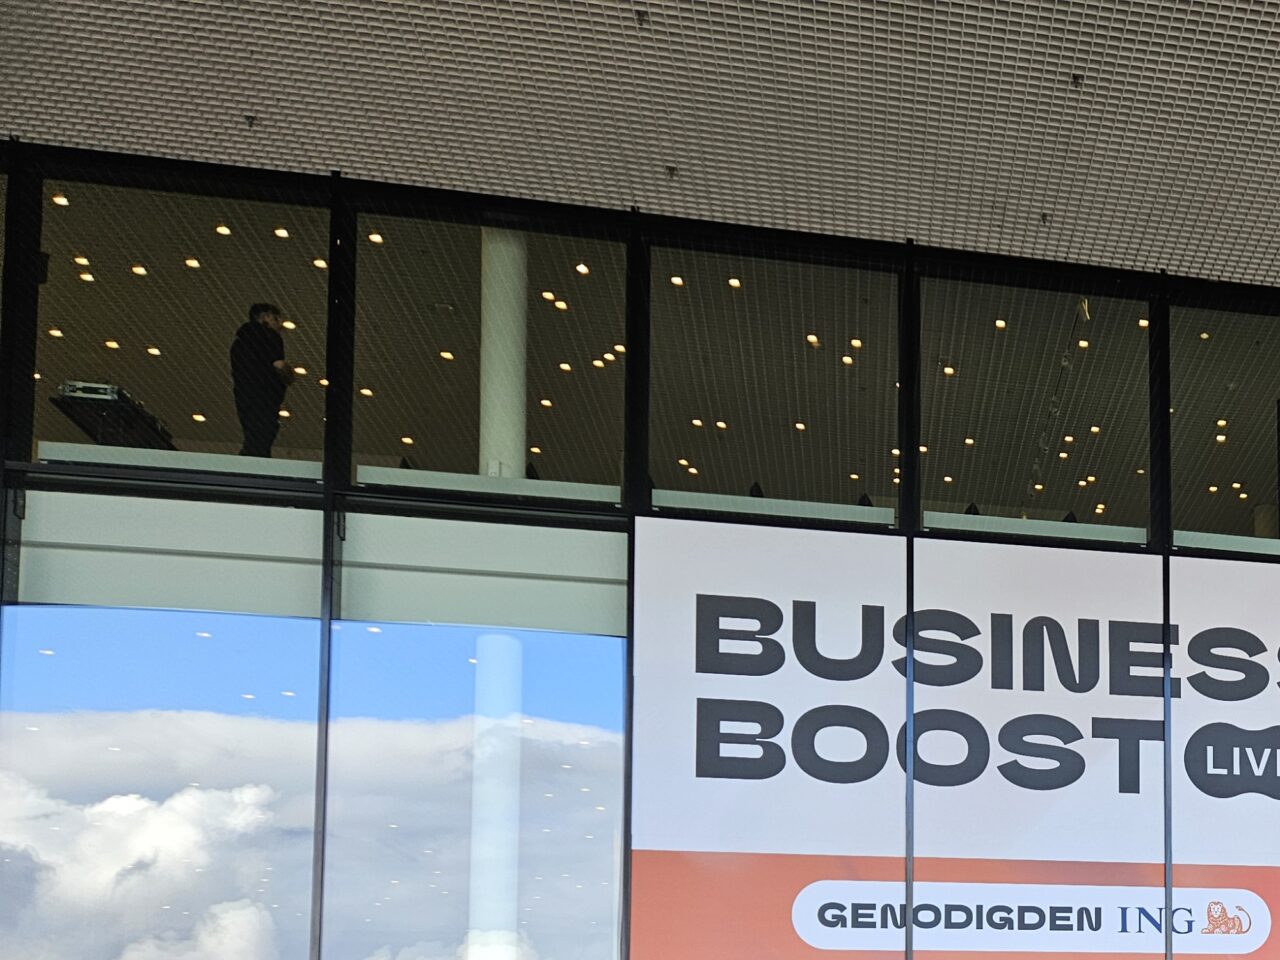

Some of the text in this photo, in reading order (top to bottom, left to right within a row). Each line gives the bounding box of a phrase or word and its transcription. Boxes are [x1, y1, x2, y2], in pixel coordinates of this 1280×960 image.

[695, 697, 1166, 794] BOOST
[817, 902, 1196, 935] GENODIGDEN ING
